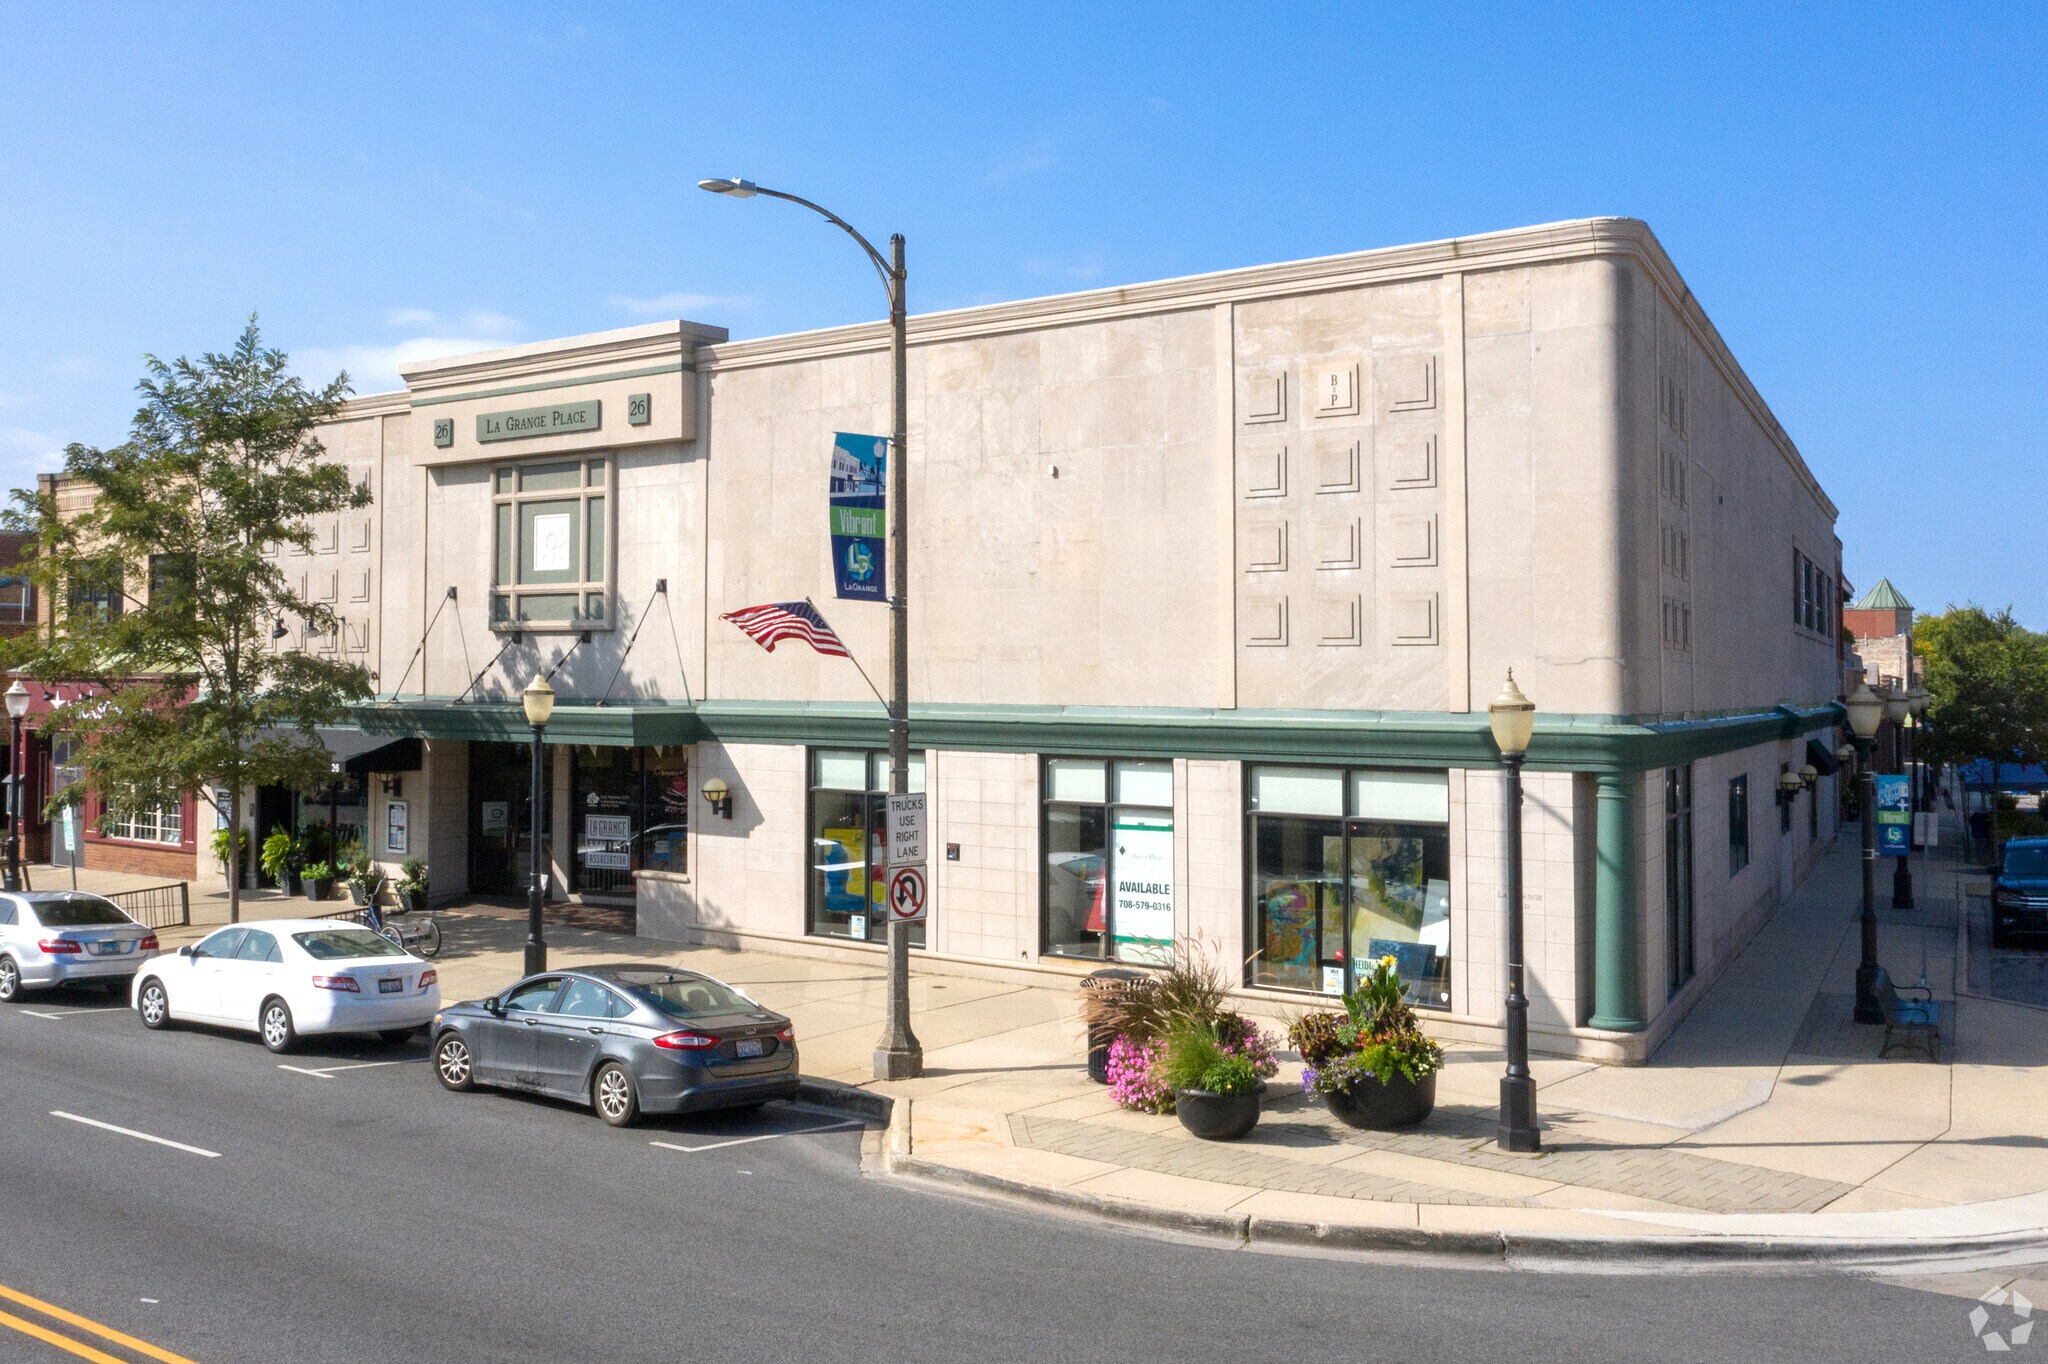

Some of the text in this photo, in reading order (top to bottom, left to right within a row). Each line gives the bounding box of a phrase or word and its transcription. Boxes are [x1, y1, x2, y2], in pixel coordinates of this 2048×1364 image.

[1331, 374, 1338, 386] B
[1331, 394, 1338, 406] P
[629, 399, 646, 416] 26
[506, 416, 546, 431] GRANGE
[552, 410, 587, 426] PLACE
[435, 424, 449, 440] 26
[840, 508, 877, 535] Vibrant
[331, 763, 340, 773] 26
[891, 799, 923, 812] TRUCKS
[899, 815, 916, 827] USE
[896, 830, 919, 842] RIGHT
[896, 846, 919, 858] LANE
[1119, 881, 1170, 895] AVAILABLE
[1119, 899, 1171, 912] 708-579-0316
